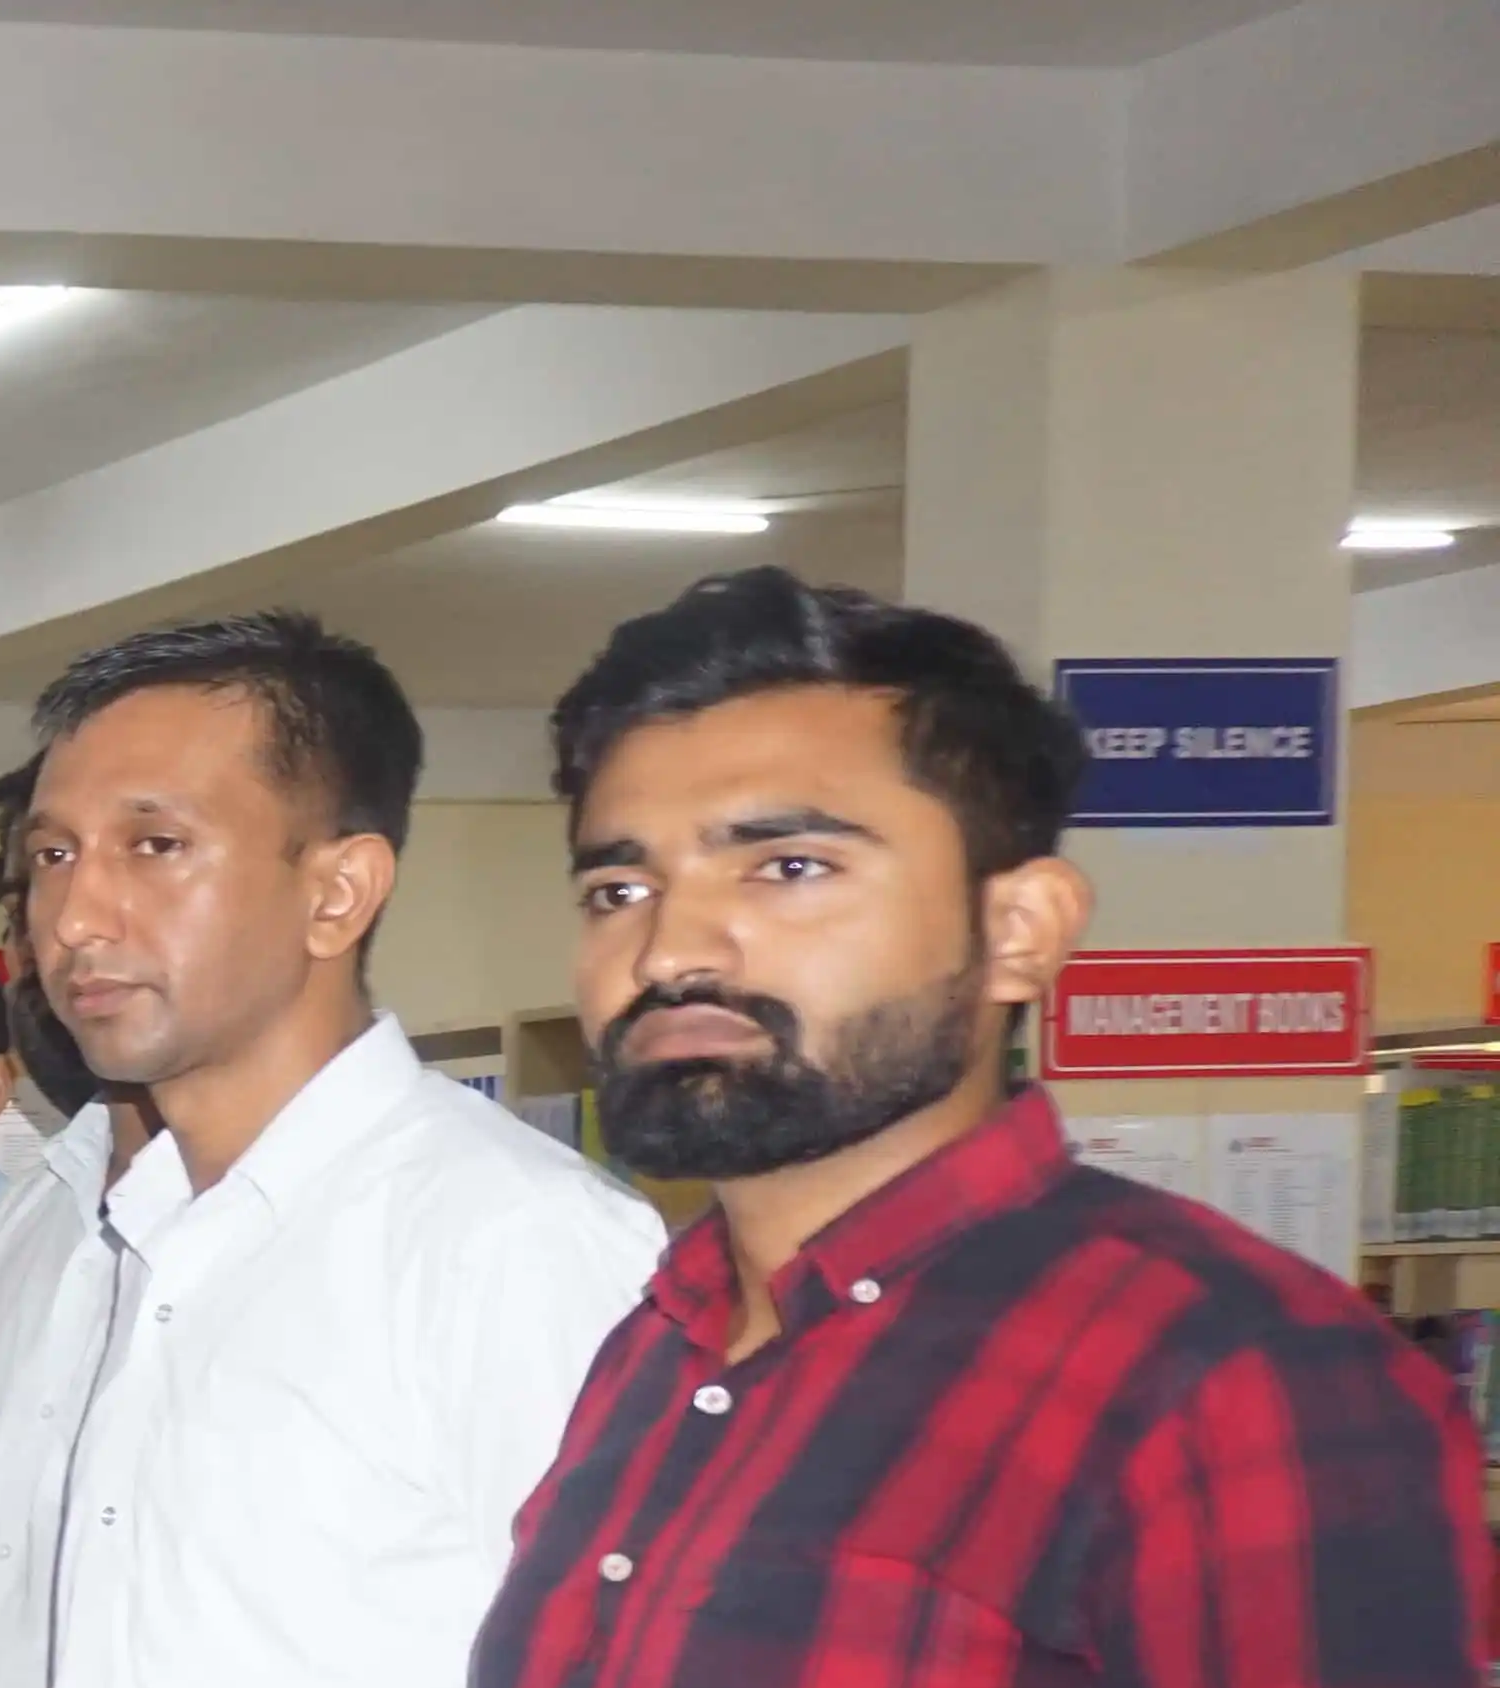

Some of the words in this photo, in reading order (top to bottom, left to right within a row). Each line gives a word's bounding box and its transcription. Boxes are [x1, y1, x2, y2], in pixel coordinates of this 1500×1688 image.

[1084, 727, 1167, 759] KEEP
[1174, 726, 1312, 758] SILENCE
[1067, 994, 1252, 1036] MANAGEMENT
[1257, 992, 1345, 1033] BOOKS
